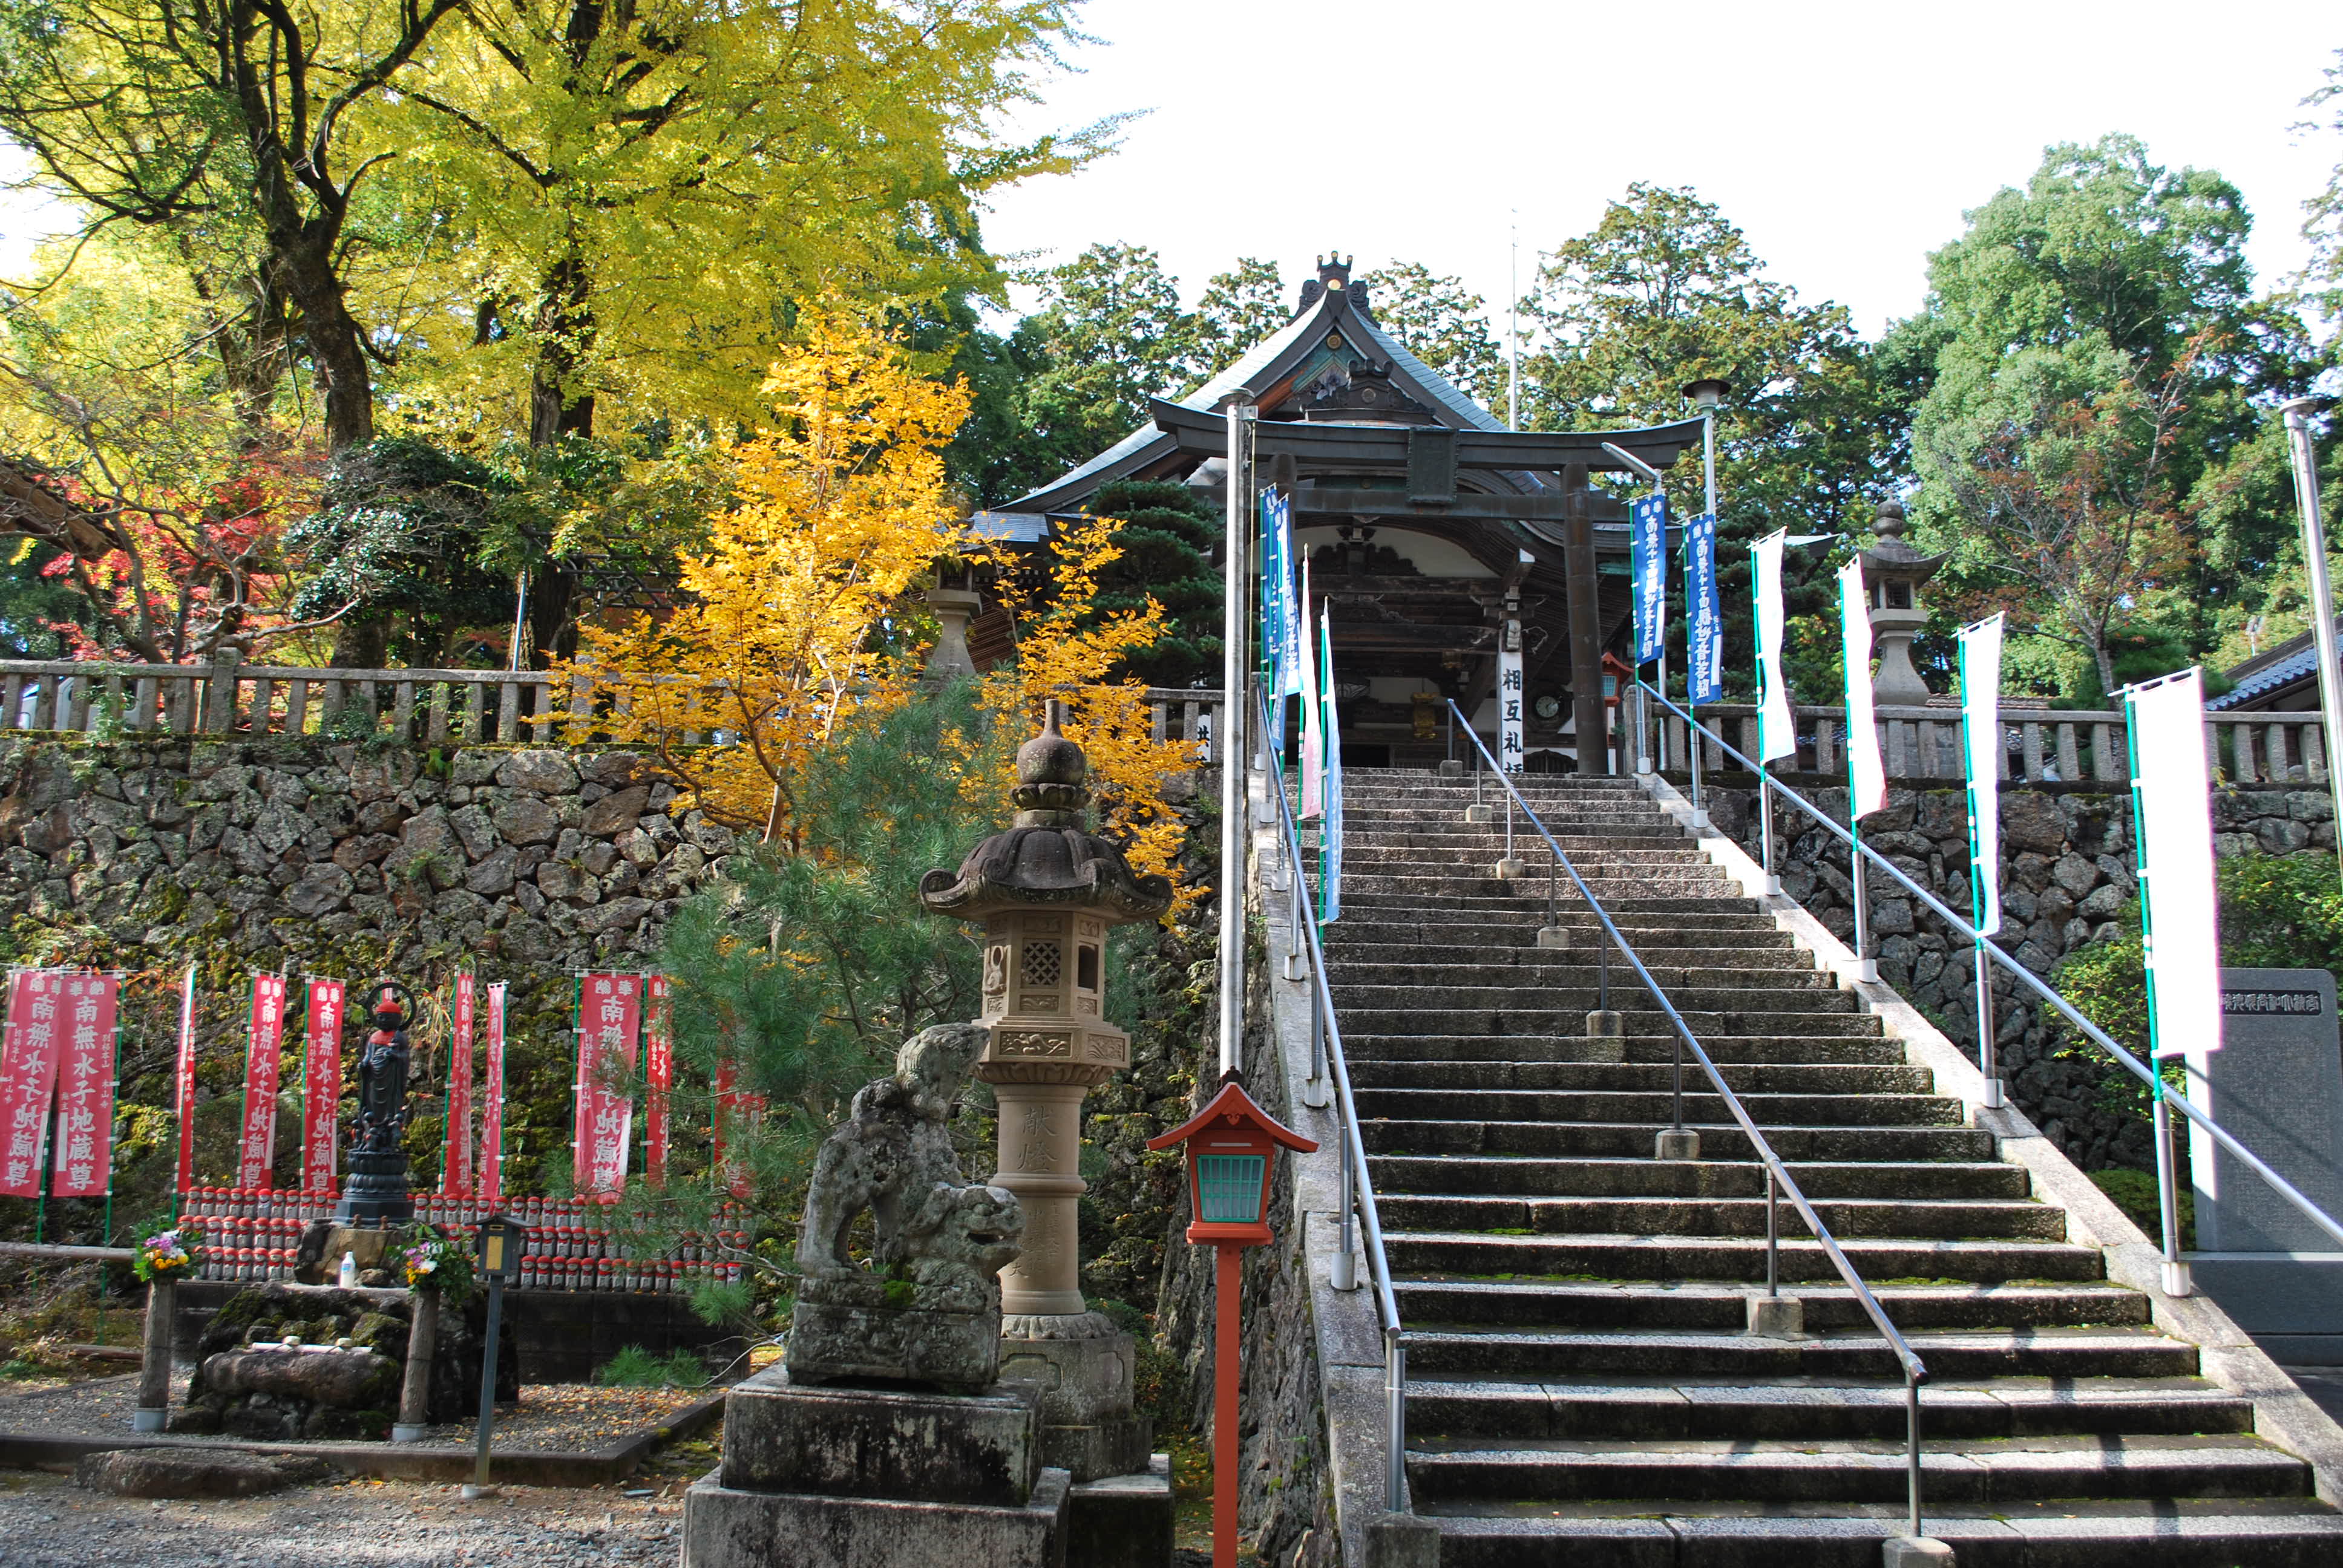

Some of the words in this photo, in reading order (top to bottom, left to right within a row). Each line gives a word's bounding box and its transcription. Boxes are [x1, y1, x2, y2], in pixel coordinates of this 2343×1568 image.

[67, 996, 99, 1191] 南無水子地蔵尊
